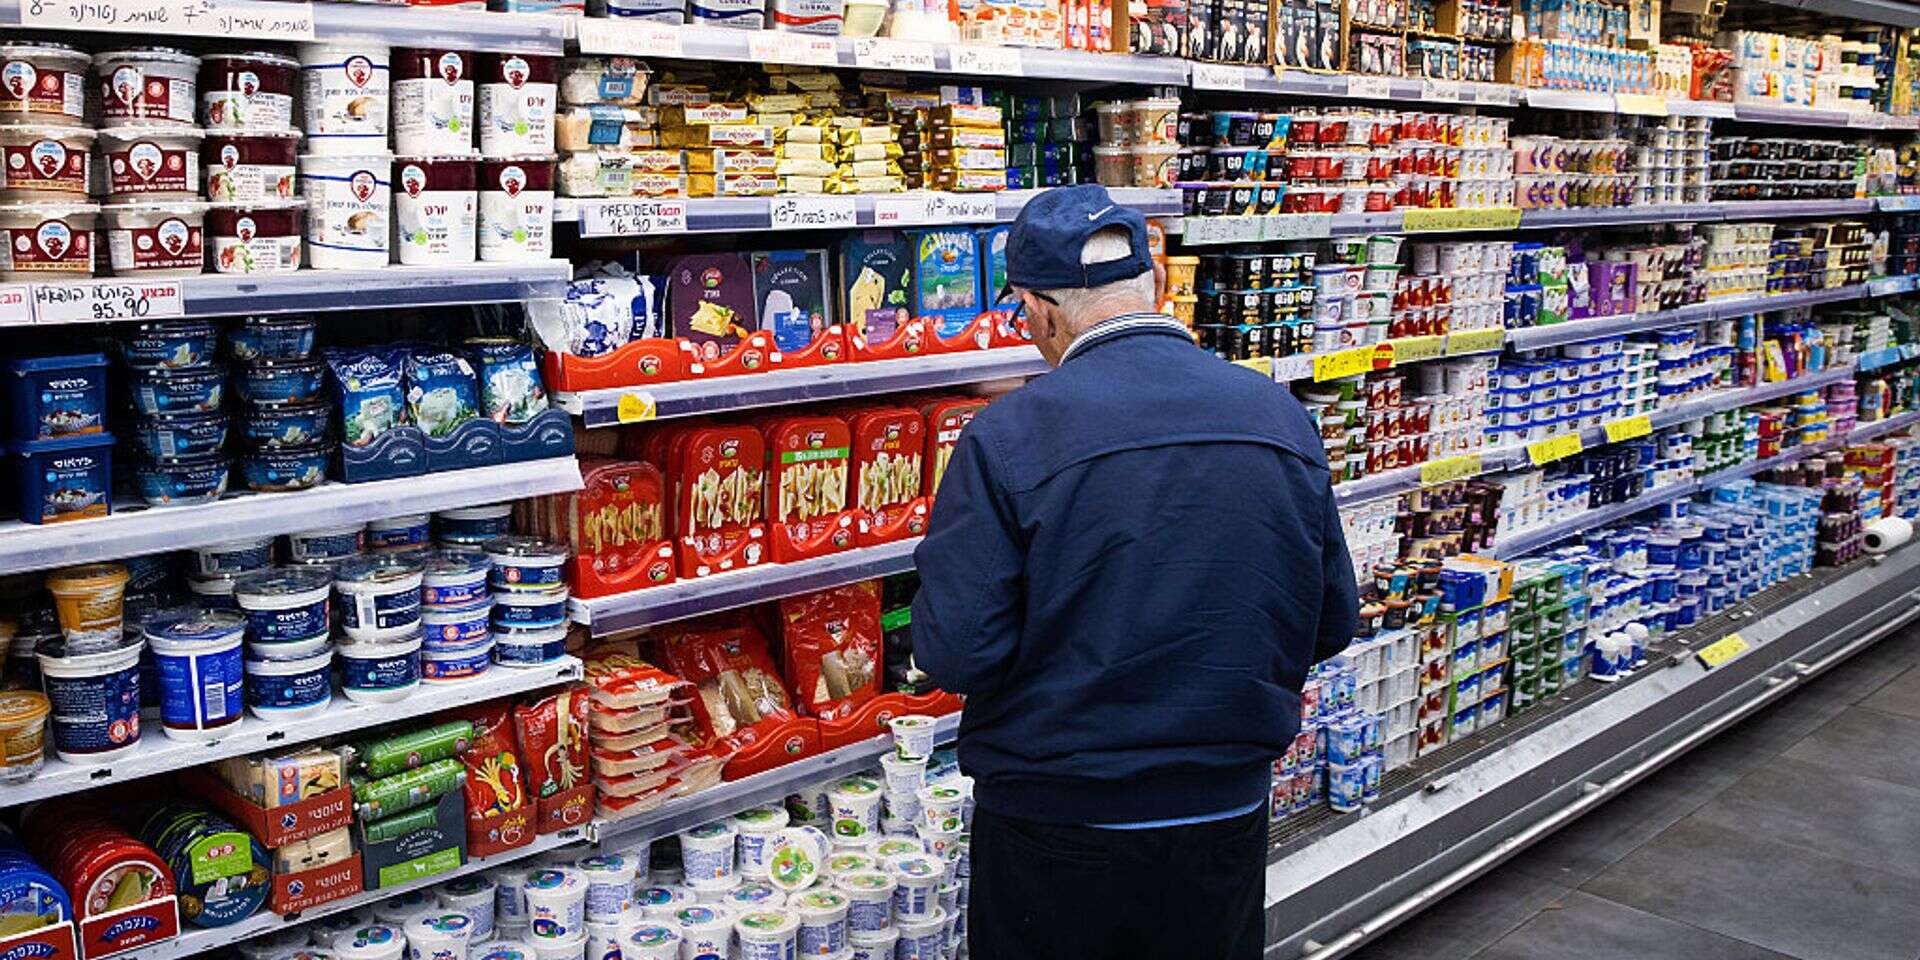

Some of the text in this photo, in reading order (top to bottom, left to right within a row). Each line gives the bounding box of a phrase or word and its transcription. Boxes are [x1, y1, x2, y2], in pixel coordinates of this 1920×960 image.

[1257, 123, 1273, 136] GO
[1227, 157, 1243, 169] GO
[1235, 190, 1250, 203] GO
[1261, 190, 1276, 202] GO
[600, 203, 662, 218] PRESIDENT
[140, 287, 176, 299] מבצע
[54, 457, 93, 468] פיראוס
[114, 916, 147, 934] נעמה
